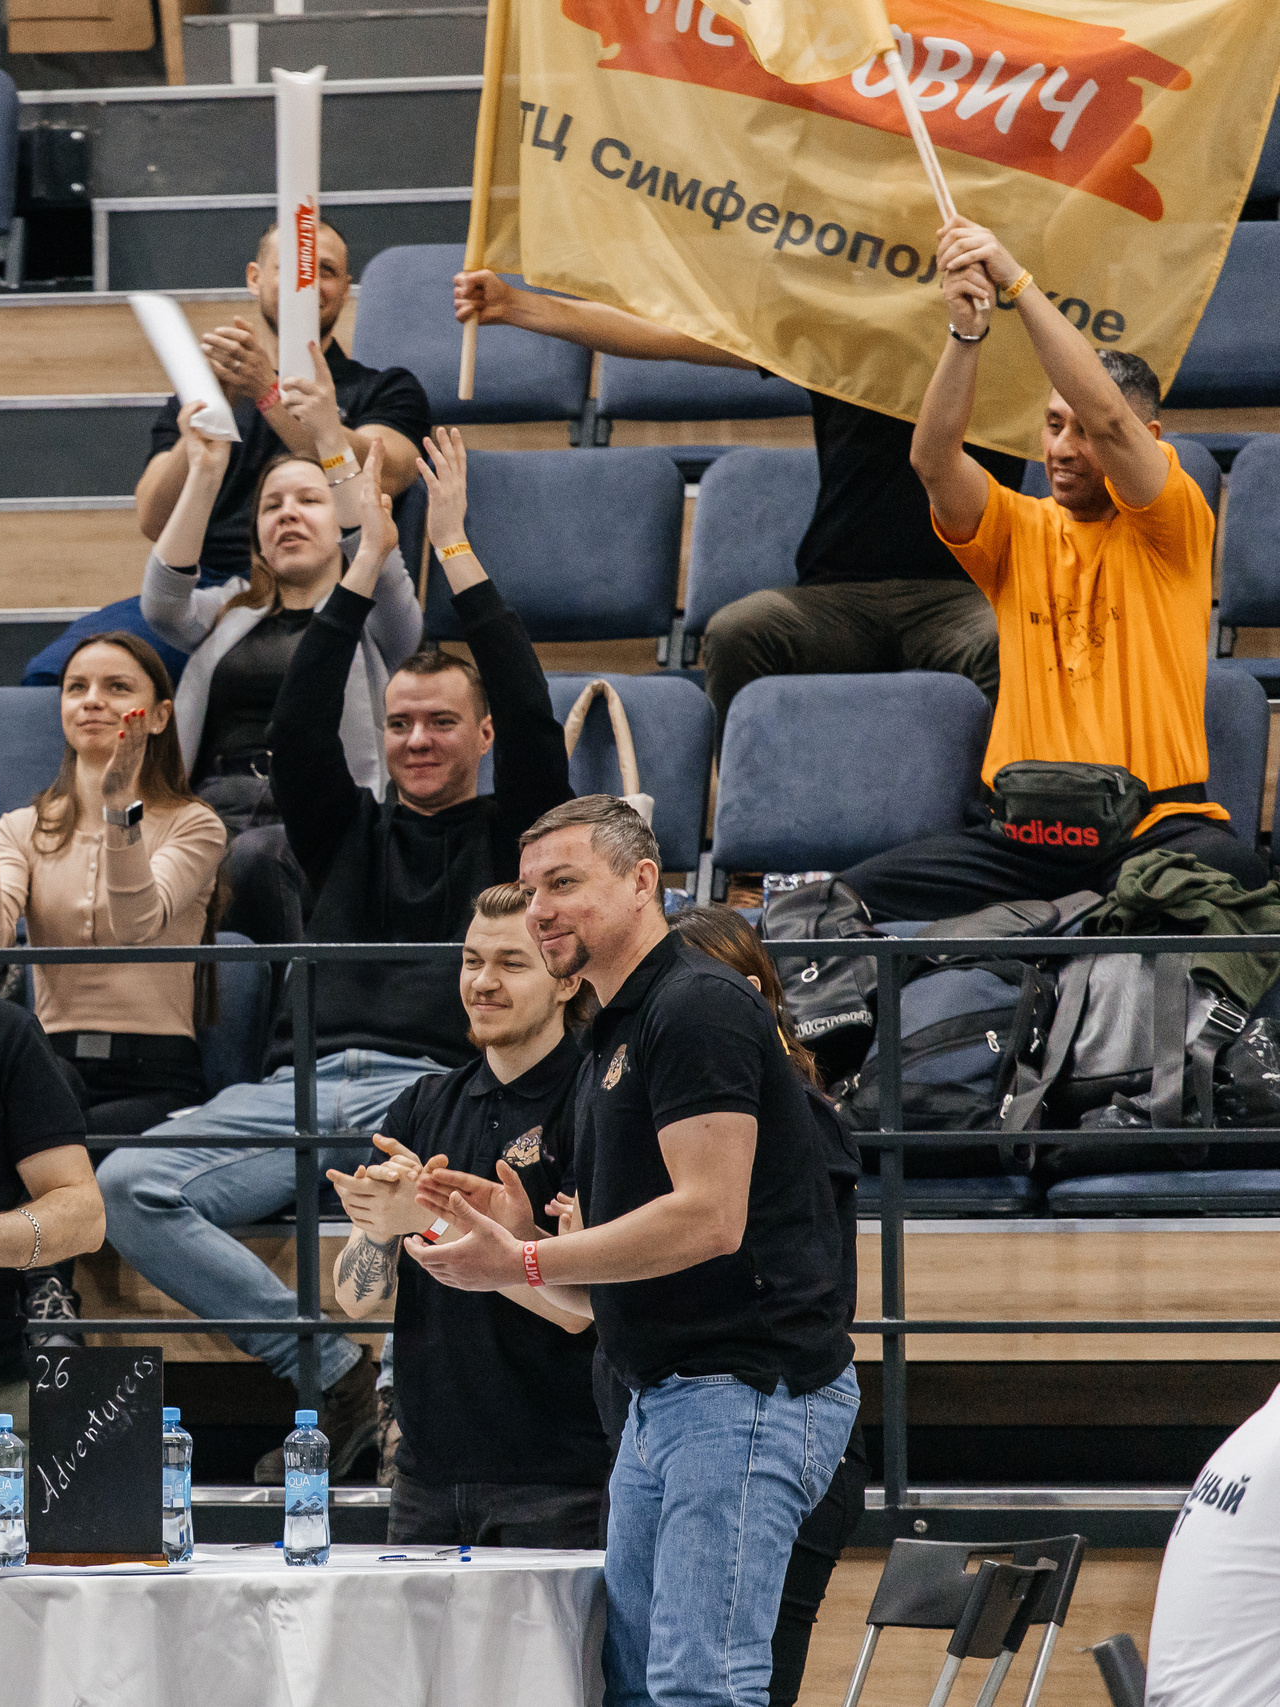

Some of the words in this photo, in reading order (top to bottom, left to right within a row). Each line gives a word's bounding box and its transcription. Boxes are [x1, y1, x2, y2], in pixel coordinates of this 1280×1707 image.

[1004, 819, 1100, 847] adidas
[36, 1355, 70, 1392] 26
[37, 1355, 154, 1514] Adventurers
